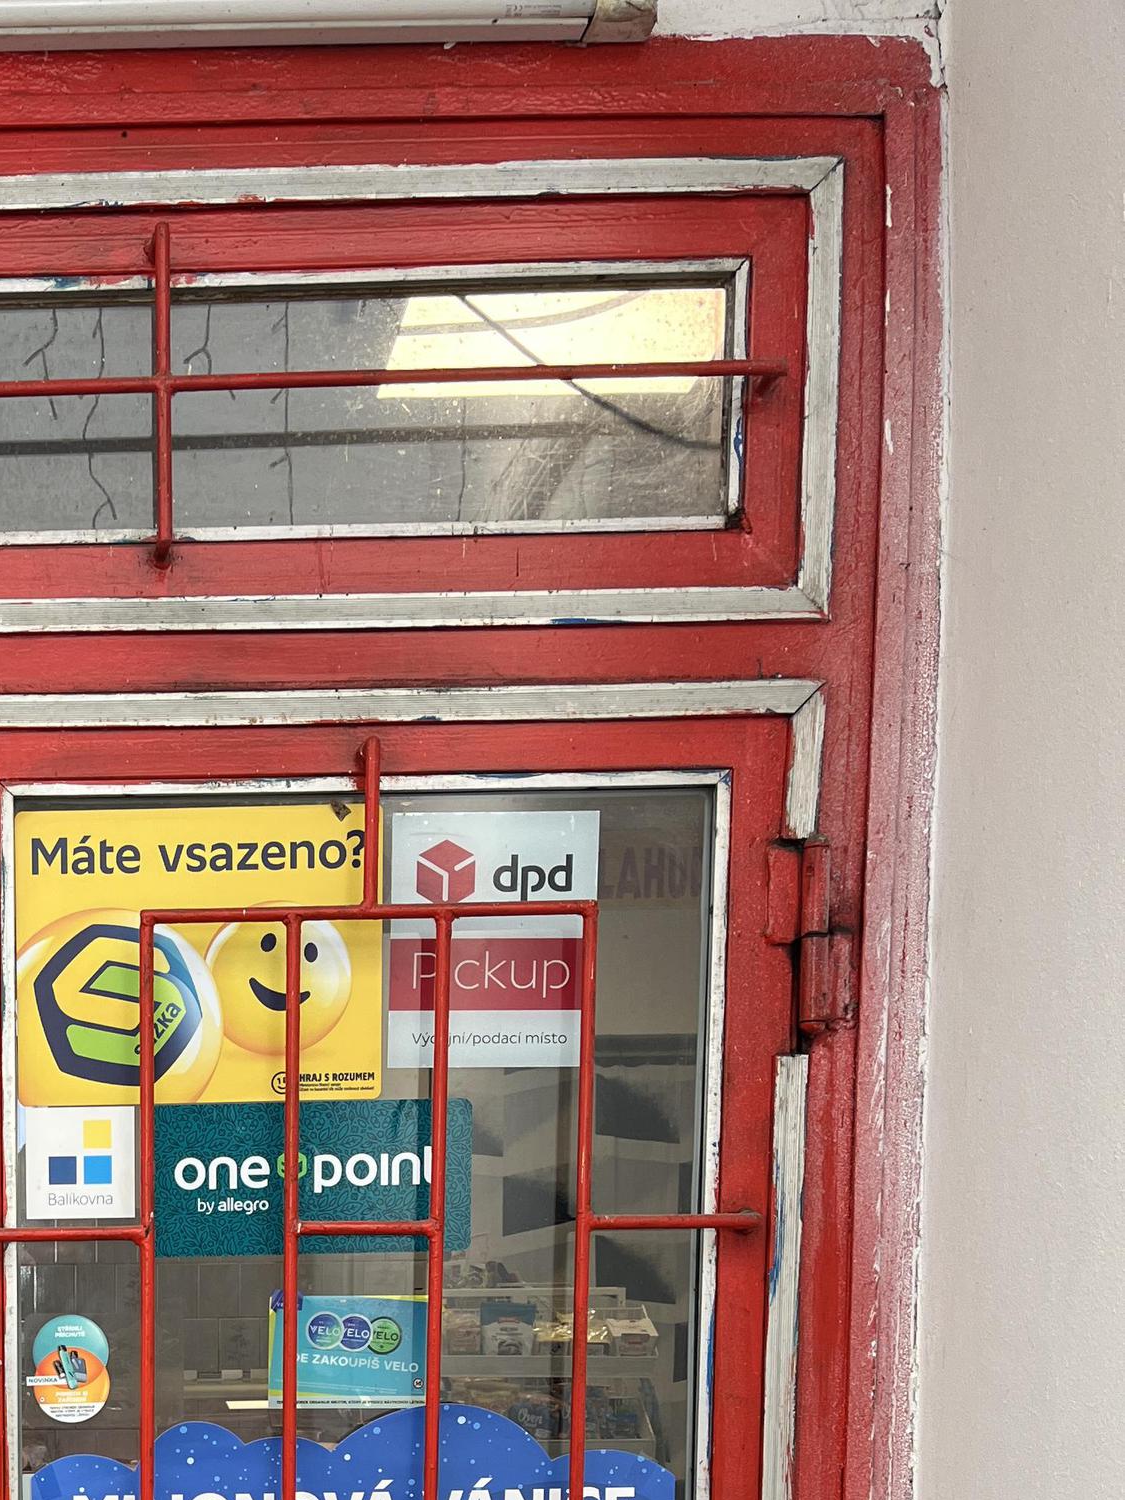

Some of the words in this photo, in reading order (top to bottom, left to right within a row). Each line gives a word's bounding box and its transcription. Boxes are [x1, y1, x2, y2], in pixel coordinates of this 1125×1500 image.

[31, 834, 142, 876] Máte
[158, 829, 365, 873] vsazeno?
[492, 853, 574, 901] dpd
[412, 950, 571, 999] Pckup
[525, 1032, 568, 1044] místo
[299, 1073, 322, 1082] HRAJ
[324, 1073, 330, 1082] S
[332, 1072, 375, 1082] ROZUMEM
[174, 1154, 271, 1192] one
[47, 1192, 114, 1207] Balíkovna
[197, 1198, 213, 1214] by
[217, 1196, 270, 1216] allegro
[309, 1324, 342, 1337] VELO
[311, 1353, 380, 1370] ZAKOUPÍŠ
[384, 1360, 420, 1373] VELO
